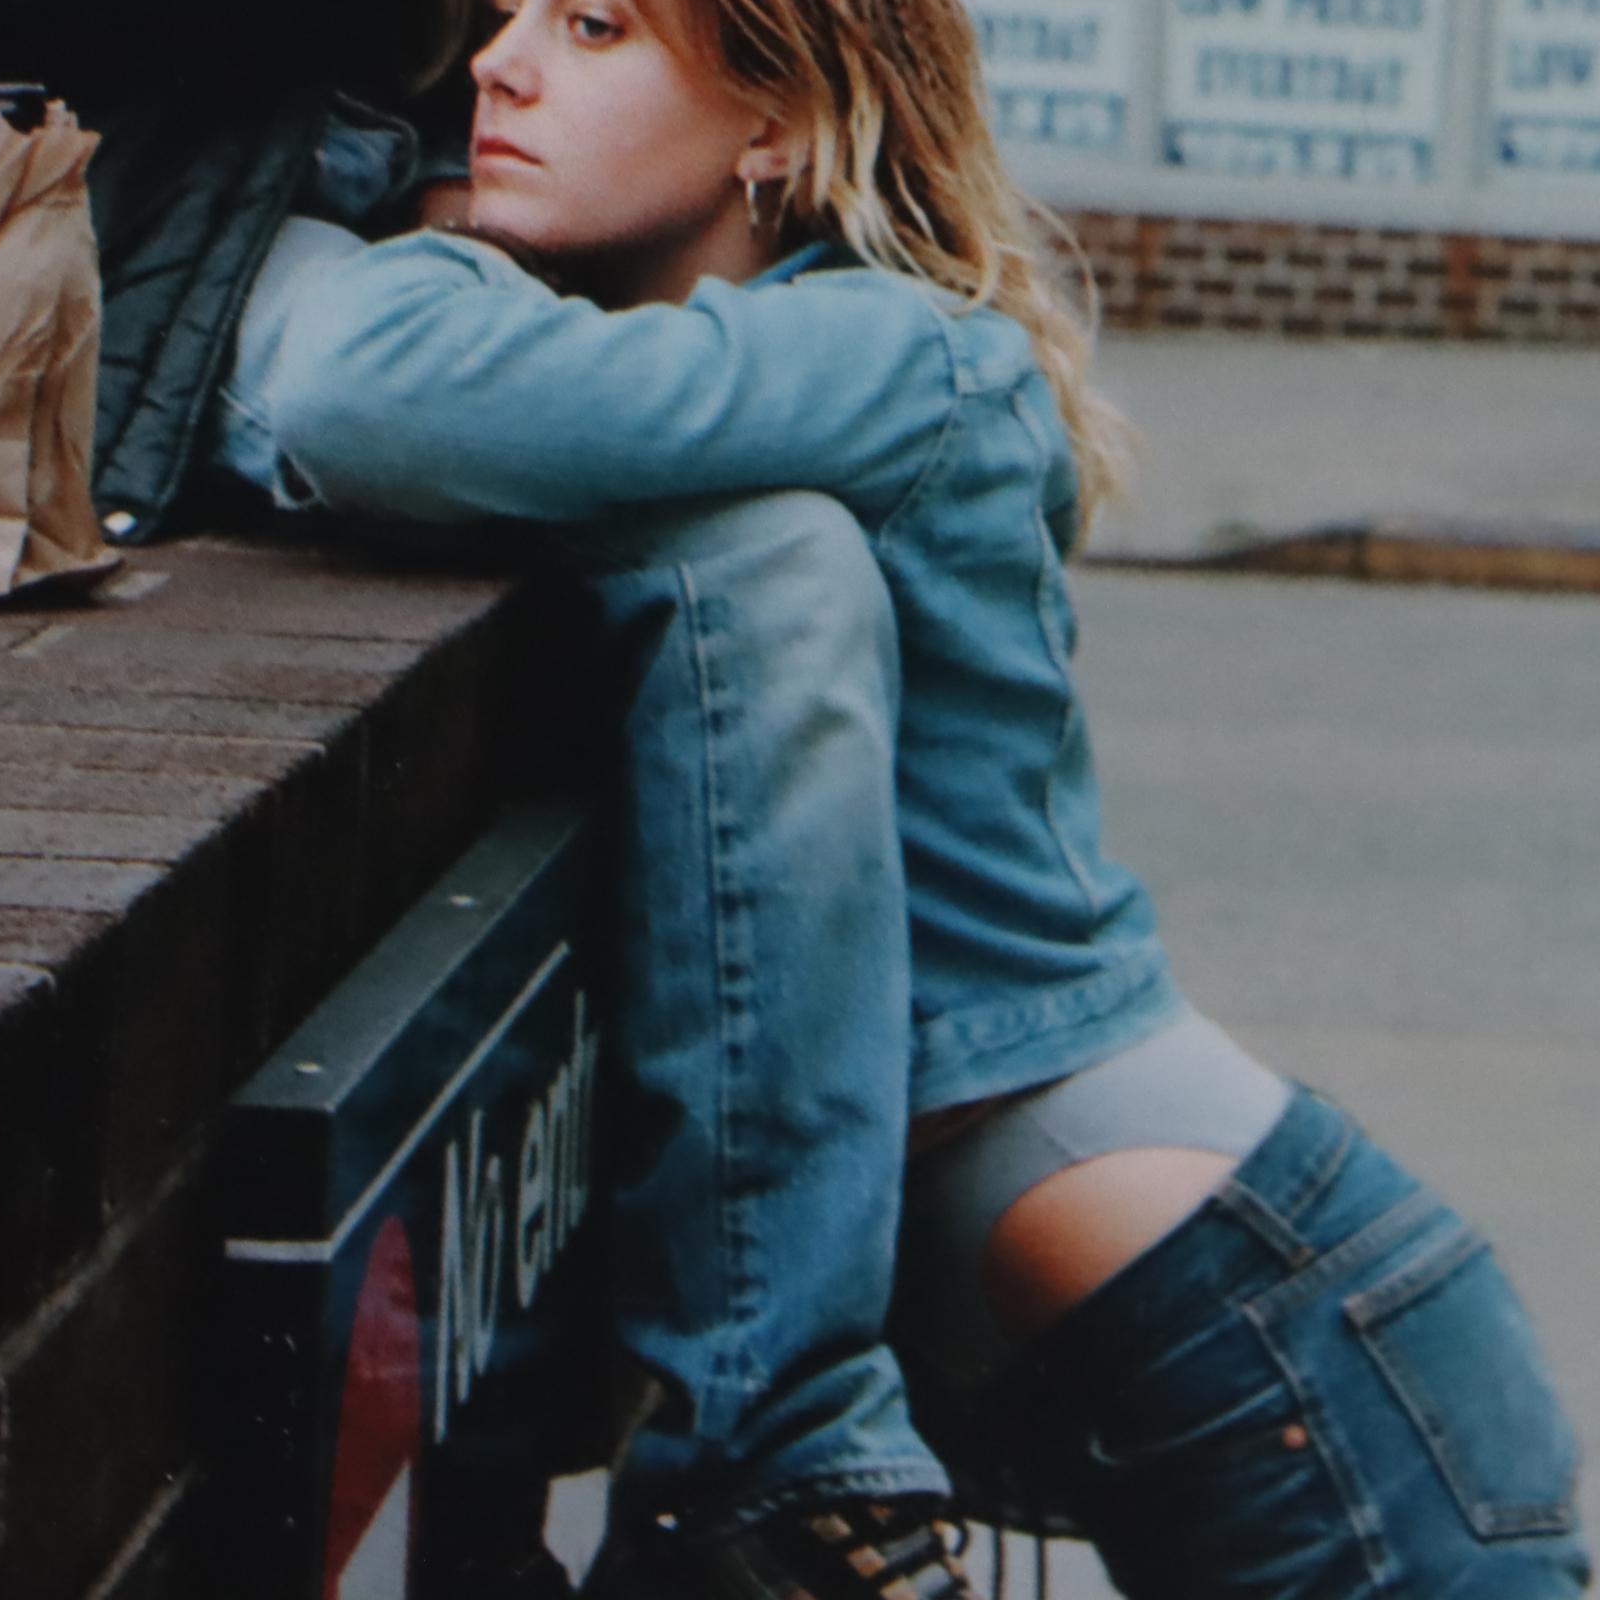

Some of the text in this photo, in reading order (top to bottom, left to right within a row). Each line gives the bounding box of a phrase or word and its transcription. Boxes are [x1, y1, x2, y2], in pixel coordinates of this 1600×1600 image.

[1195, 47, 1403, 102] EVERYDAY
[1506, 40, 1595, 90] LOW
[434, 1106, 503, 1444] No
